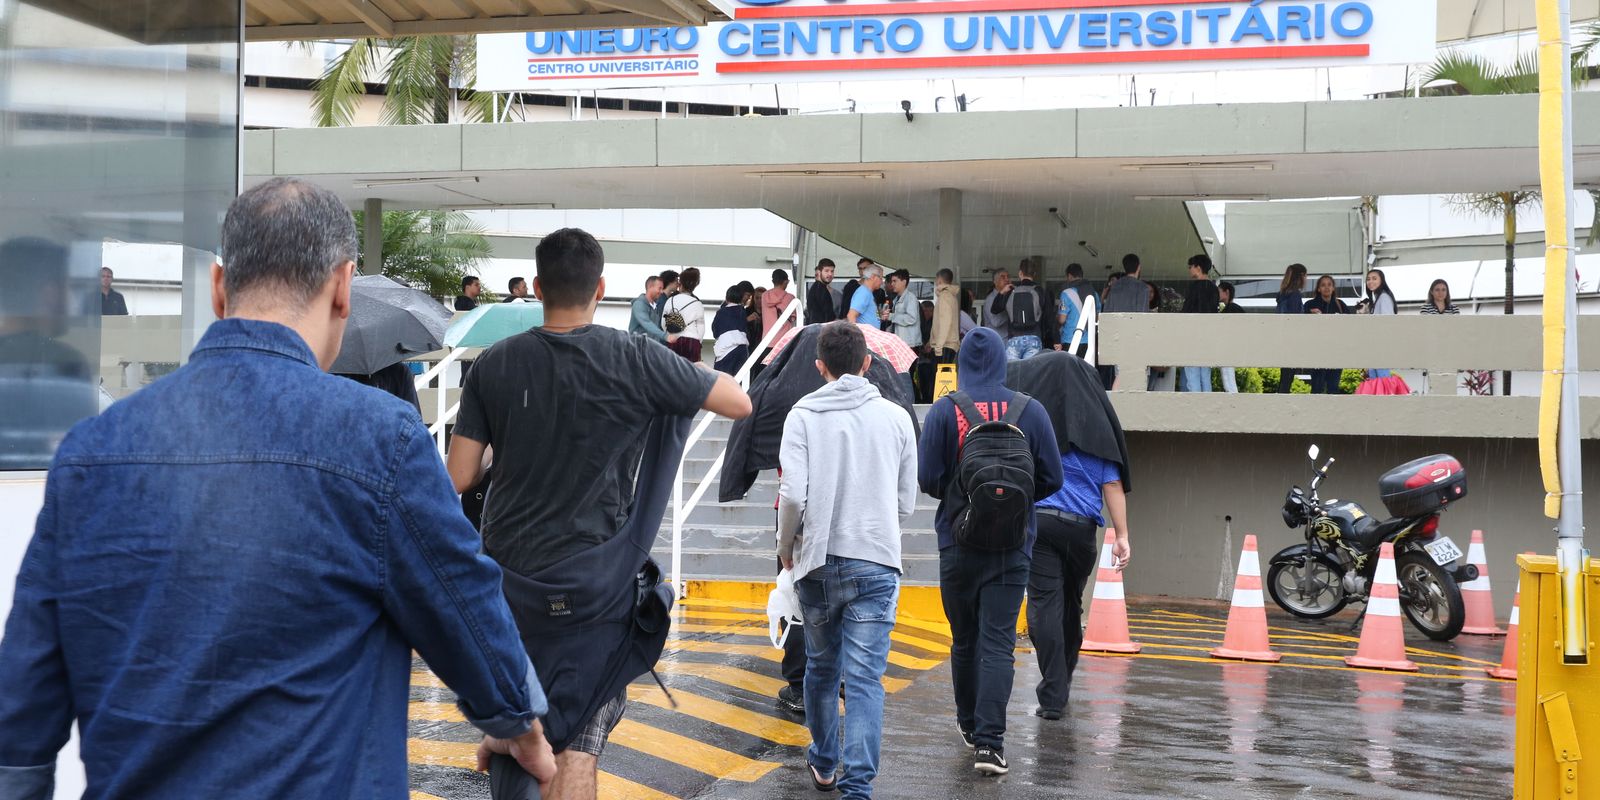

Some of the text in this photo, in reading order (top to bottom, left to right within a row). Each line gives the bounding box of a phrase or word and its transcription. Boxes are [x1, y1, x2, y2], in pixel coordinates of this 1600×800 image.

[718, 0, 1374, 56] CENTRO UNIVERSITÁRIO
[525, 26, 700, 55] UNIEURO
[528, 58, 699, 75] CENTRO UNIVERSITÁRIO
[1437, 550, 1459, 562] 4224
